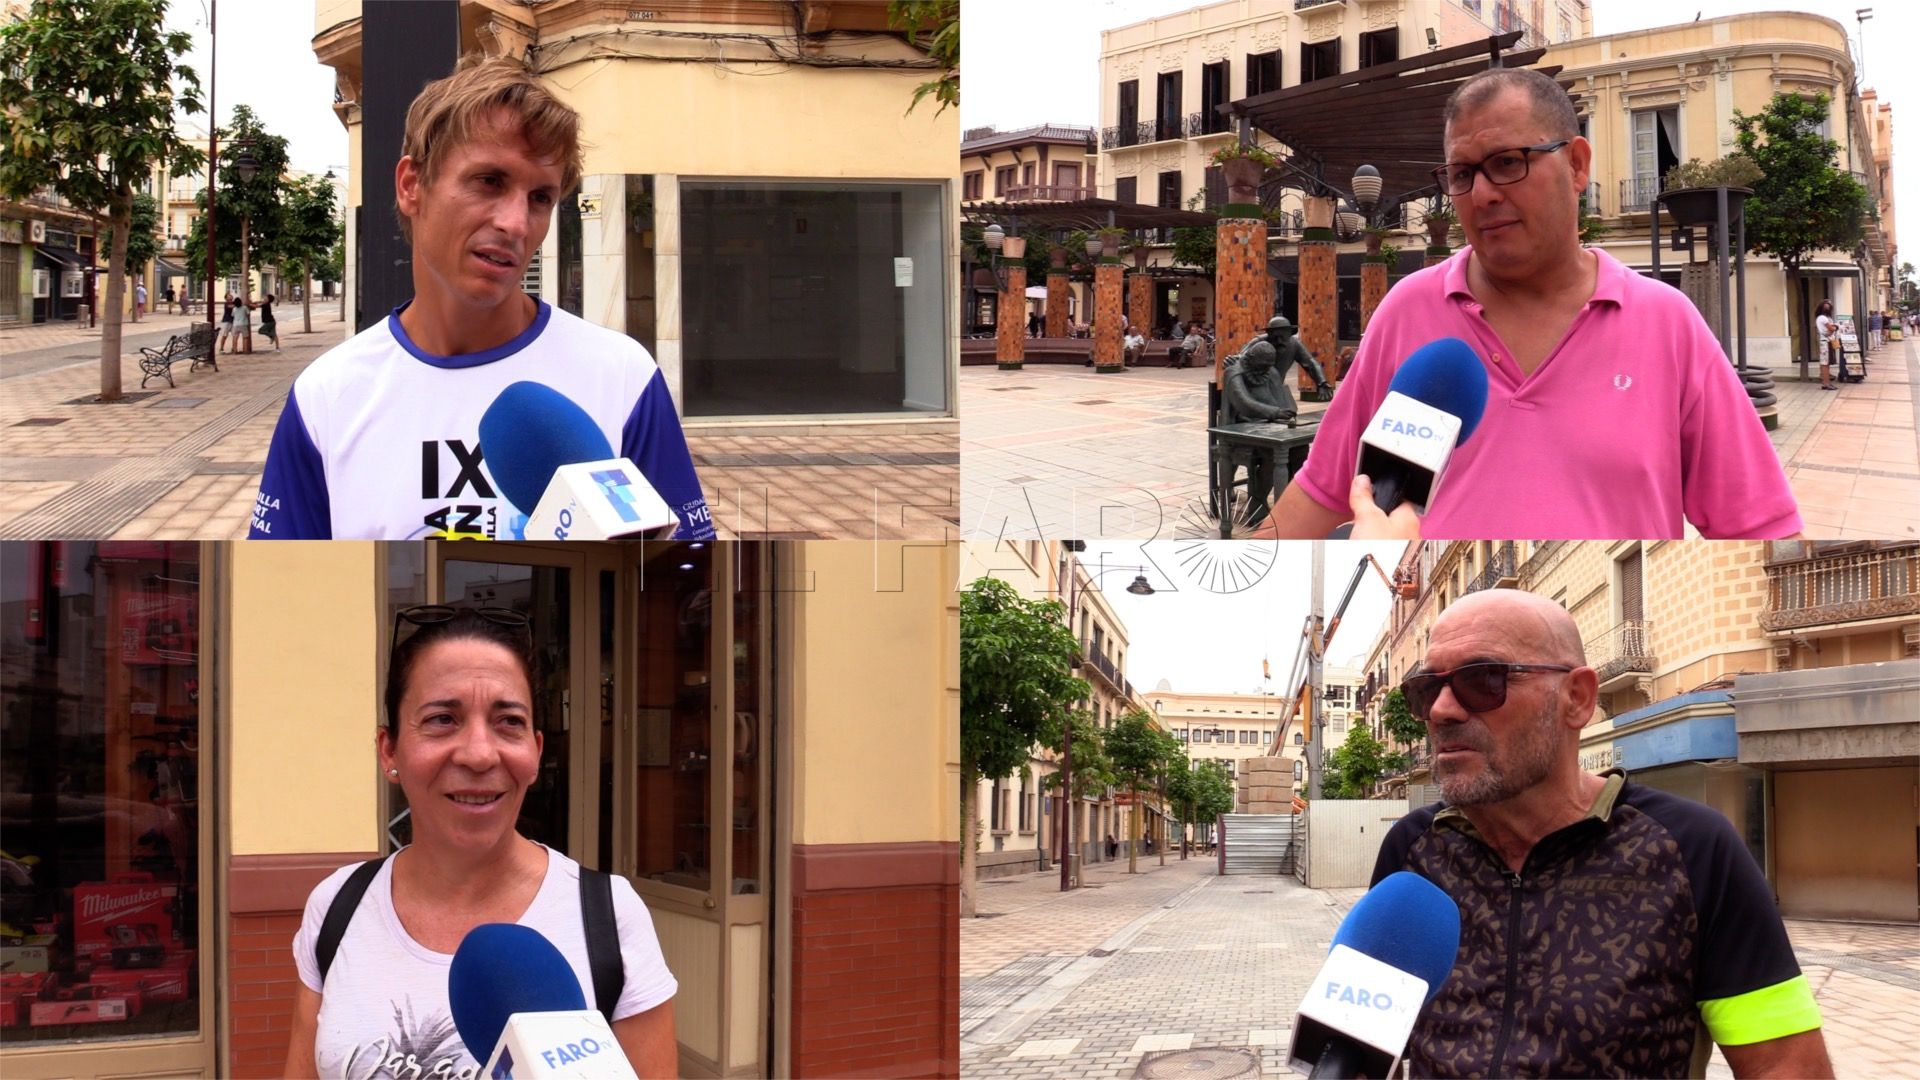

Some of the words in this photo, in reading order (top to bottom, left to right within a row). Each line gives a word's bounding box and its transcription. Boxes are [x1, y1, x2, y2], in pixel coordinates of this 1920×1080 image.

[1382, 418, 1433, 439] FARO
[422, 439, 498, 499] IX
[80, 888, 160, 917] Milwaukee
[1325, 982, 1393, 1011] FARO
[541, 1038, 600, 1069] FARO
